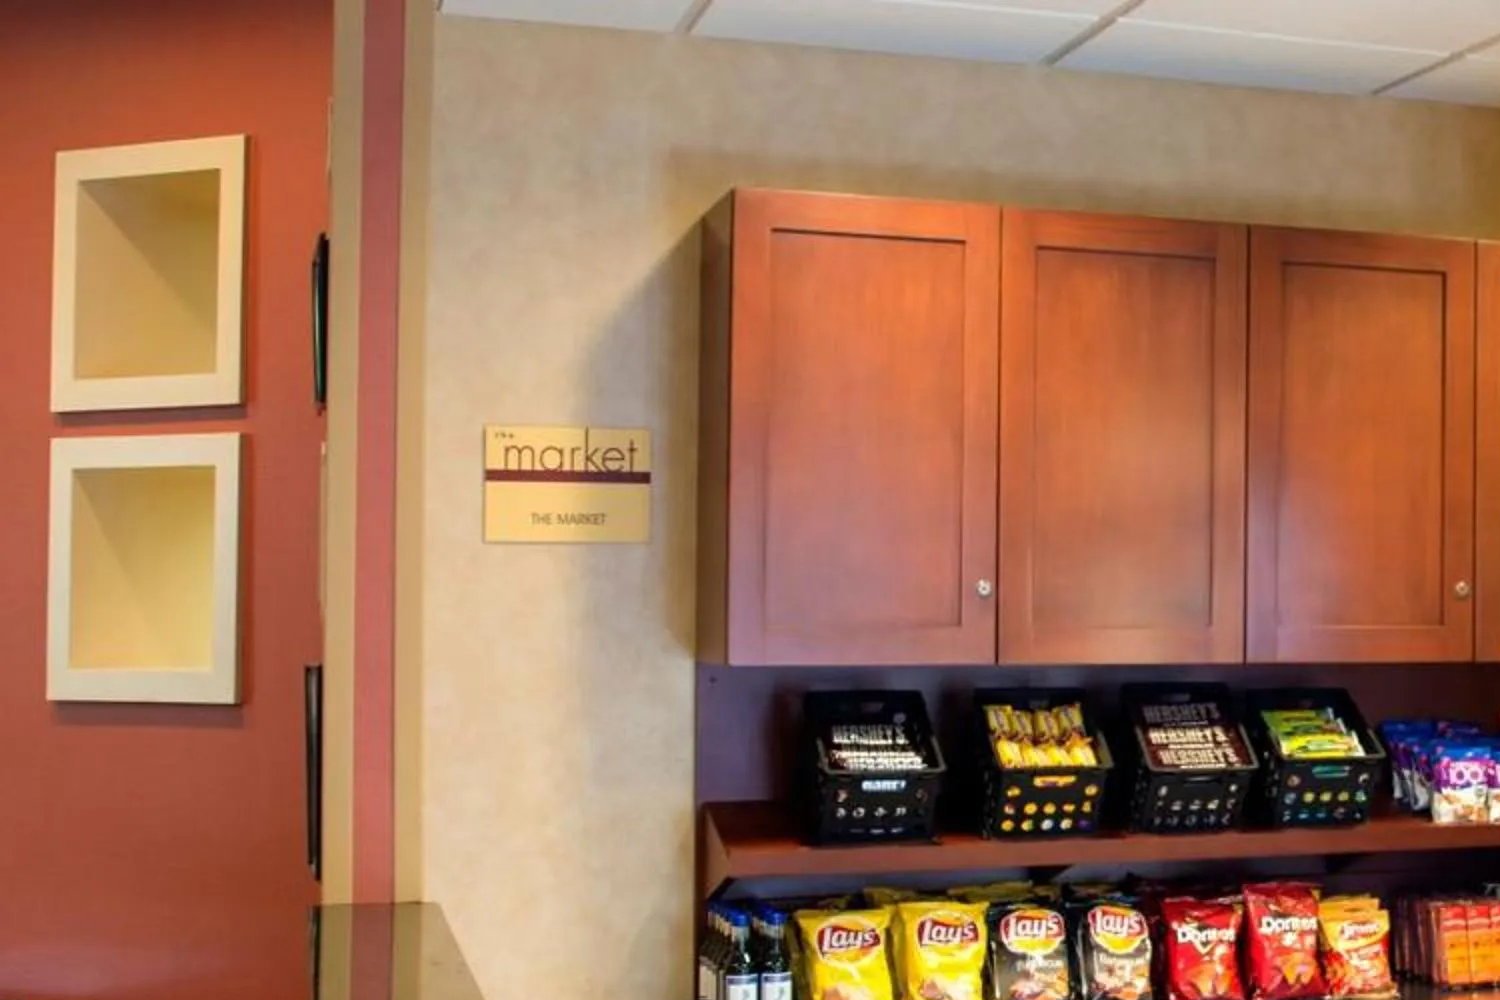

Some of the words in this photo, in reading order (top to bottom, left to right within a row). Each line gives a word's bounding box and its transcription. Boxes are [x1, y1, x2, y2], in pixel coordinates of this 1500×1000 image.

[503, 426, 639, 473] market
[530, 512, 552, 526] THE
[556, 512, 608, 526] MARKET
[1260, 915, 1318, 934] Doritos
[1177, 926, 1237, 943] Doritos
